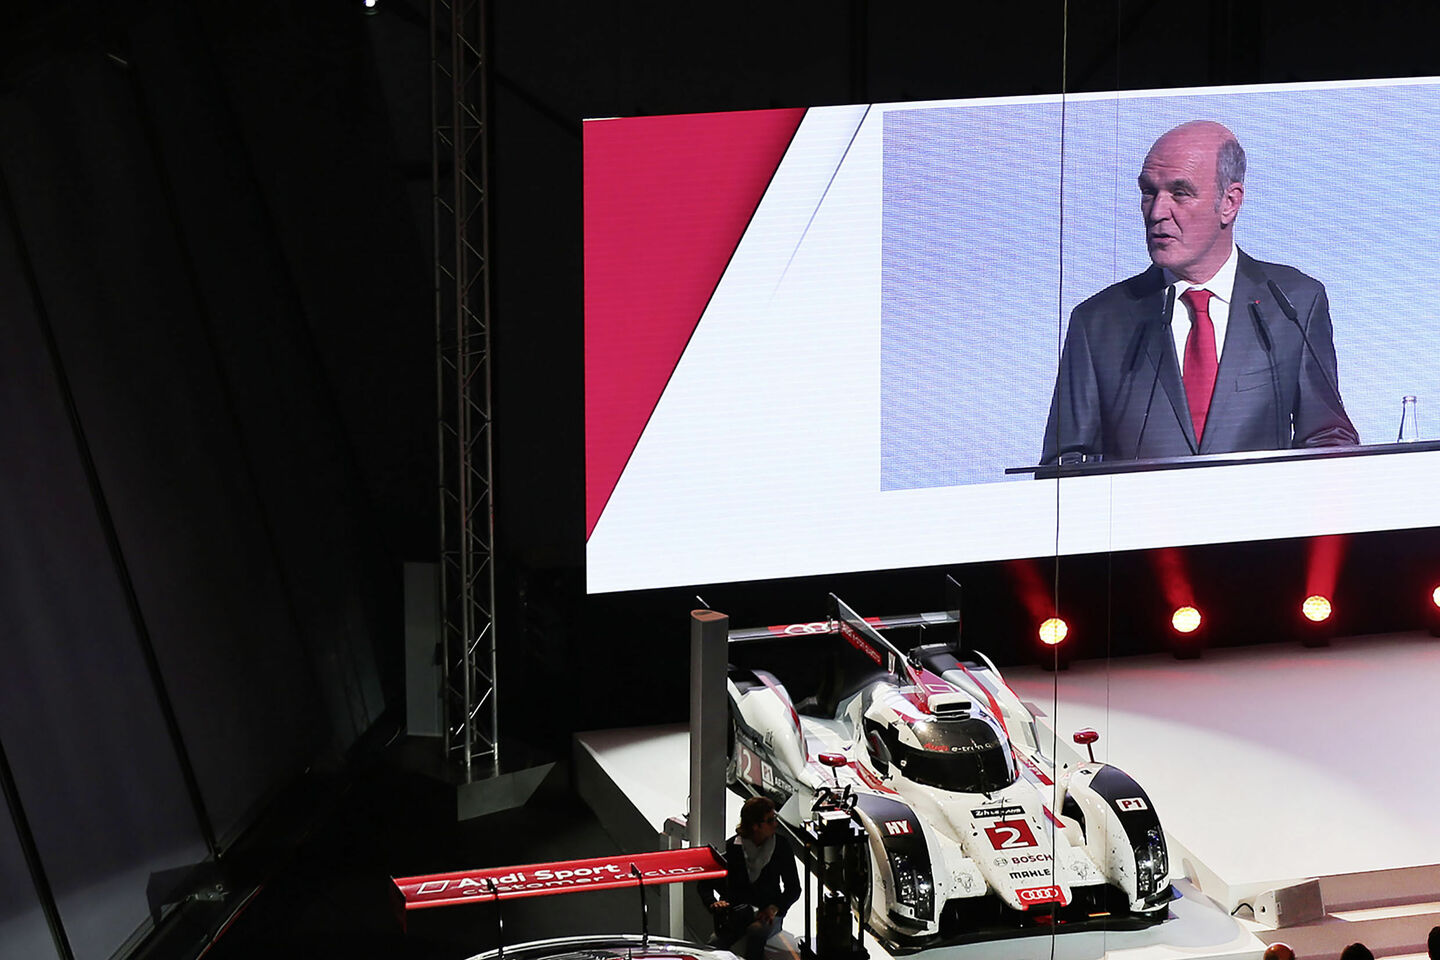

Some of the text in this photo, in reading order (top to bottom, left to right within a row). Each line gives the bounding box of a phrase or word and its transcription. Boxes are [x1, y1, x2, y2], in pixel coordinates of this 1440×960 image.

[1121, 799, 1142, 809] P1
[885, 820, 909, 834] HY
[995, 827, 1029, 848] 2
[1011, 854, 1053, 864] BOSCH
[458, 863, 620, 889] Audi Sport
[1009, 868, 1051, 879] MAHLE
